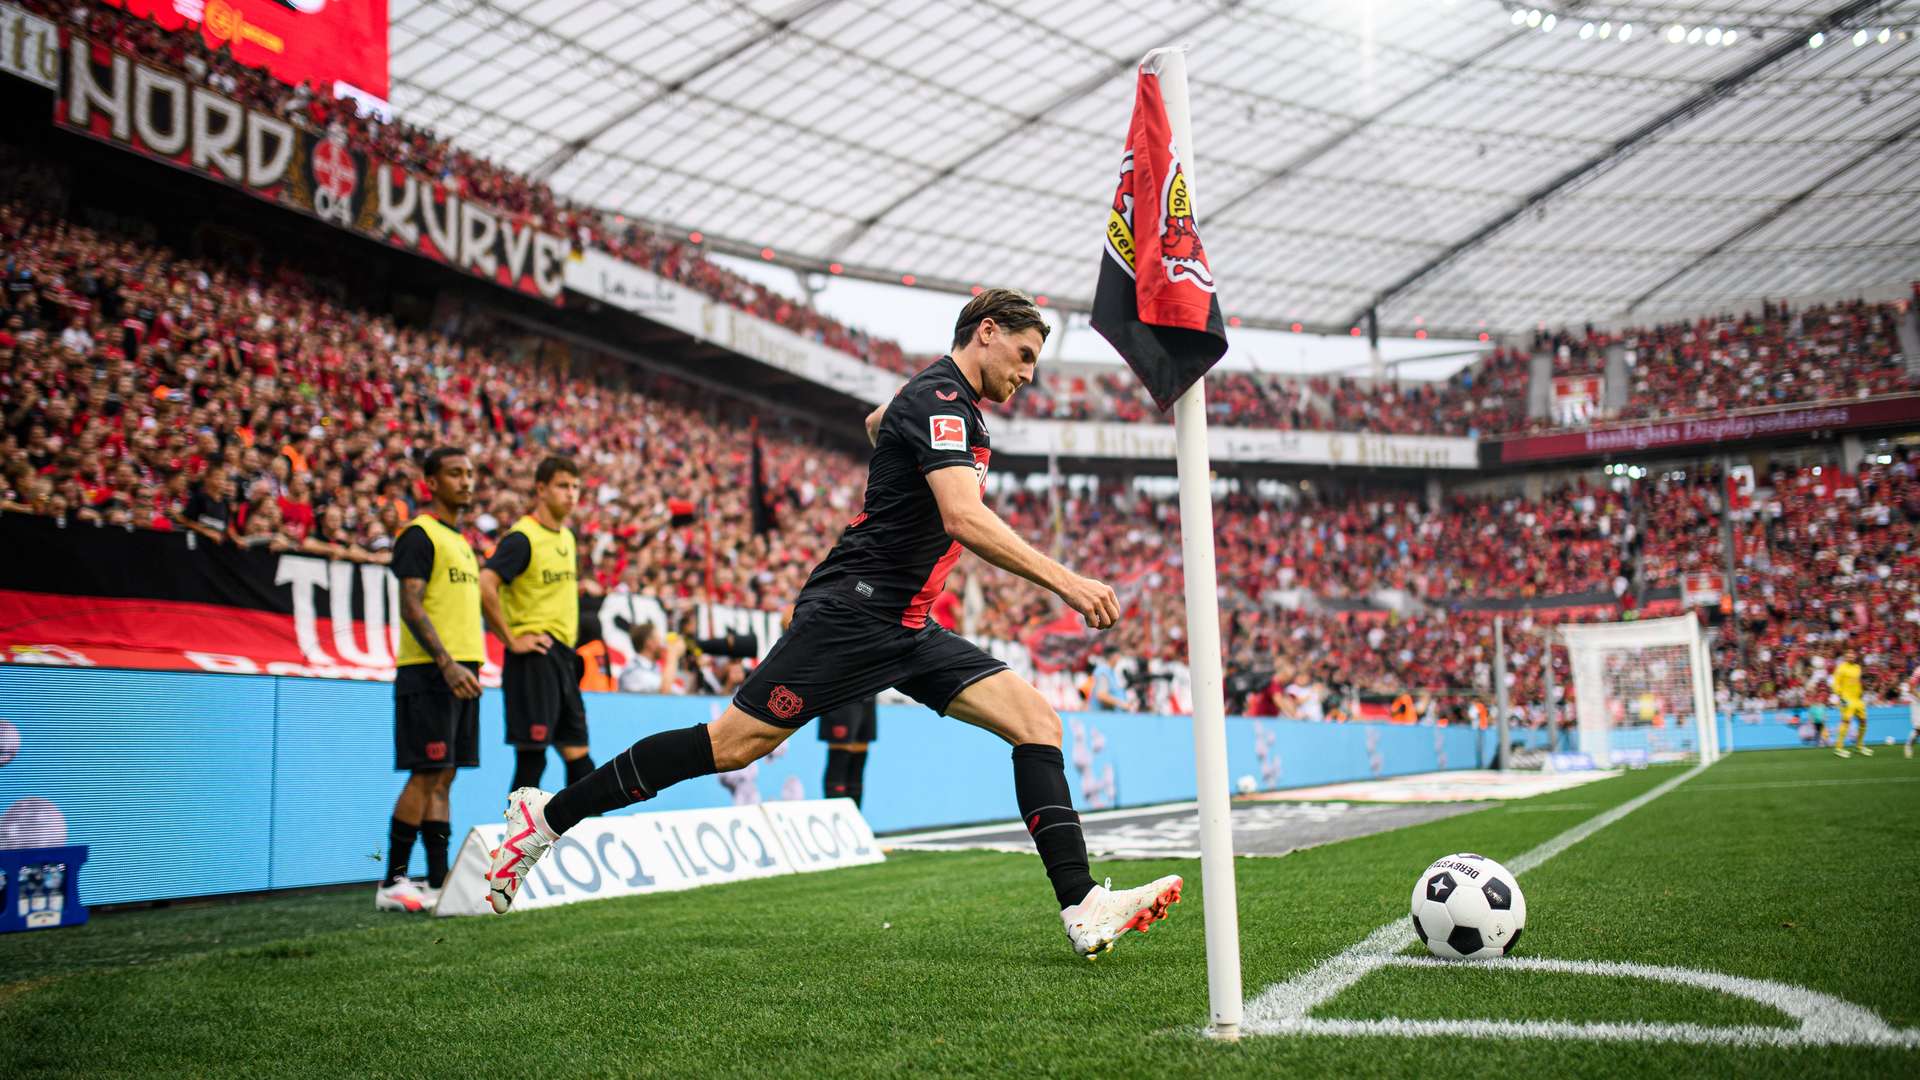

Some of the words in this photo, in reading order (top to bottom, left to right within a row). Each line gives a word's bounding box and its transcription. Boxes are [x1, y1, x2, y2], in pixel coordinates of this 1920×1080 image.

[67, 37, 297, 188] NORD
[314, 185, 352, 230] 04
[377, 163, 567, 299] KURVE
[1108, 220, 1135, 264] ever
[654, 818, 767, 879] iLOQ
[777, 811, 870, 860] iLOQ
[1429, 860, 1480, 880] DERBYST
